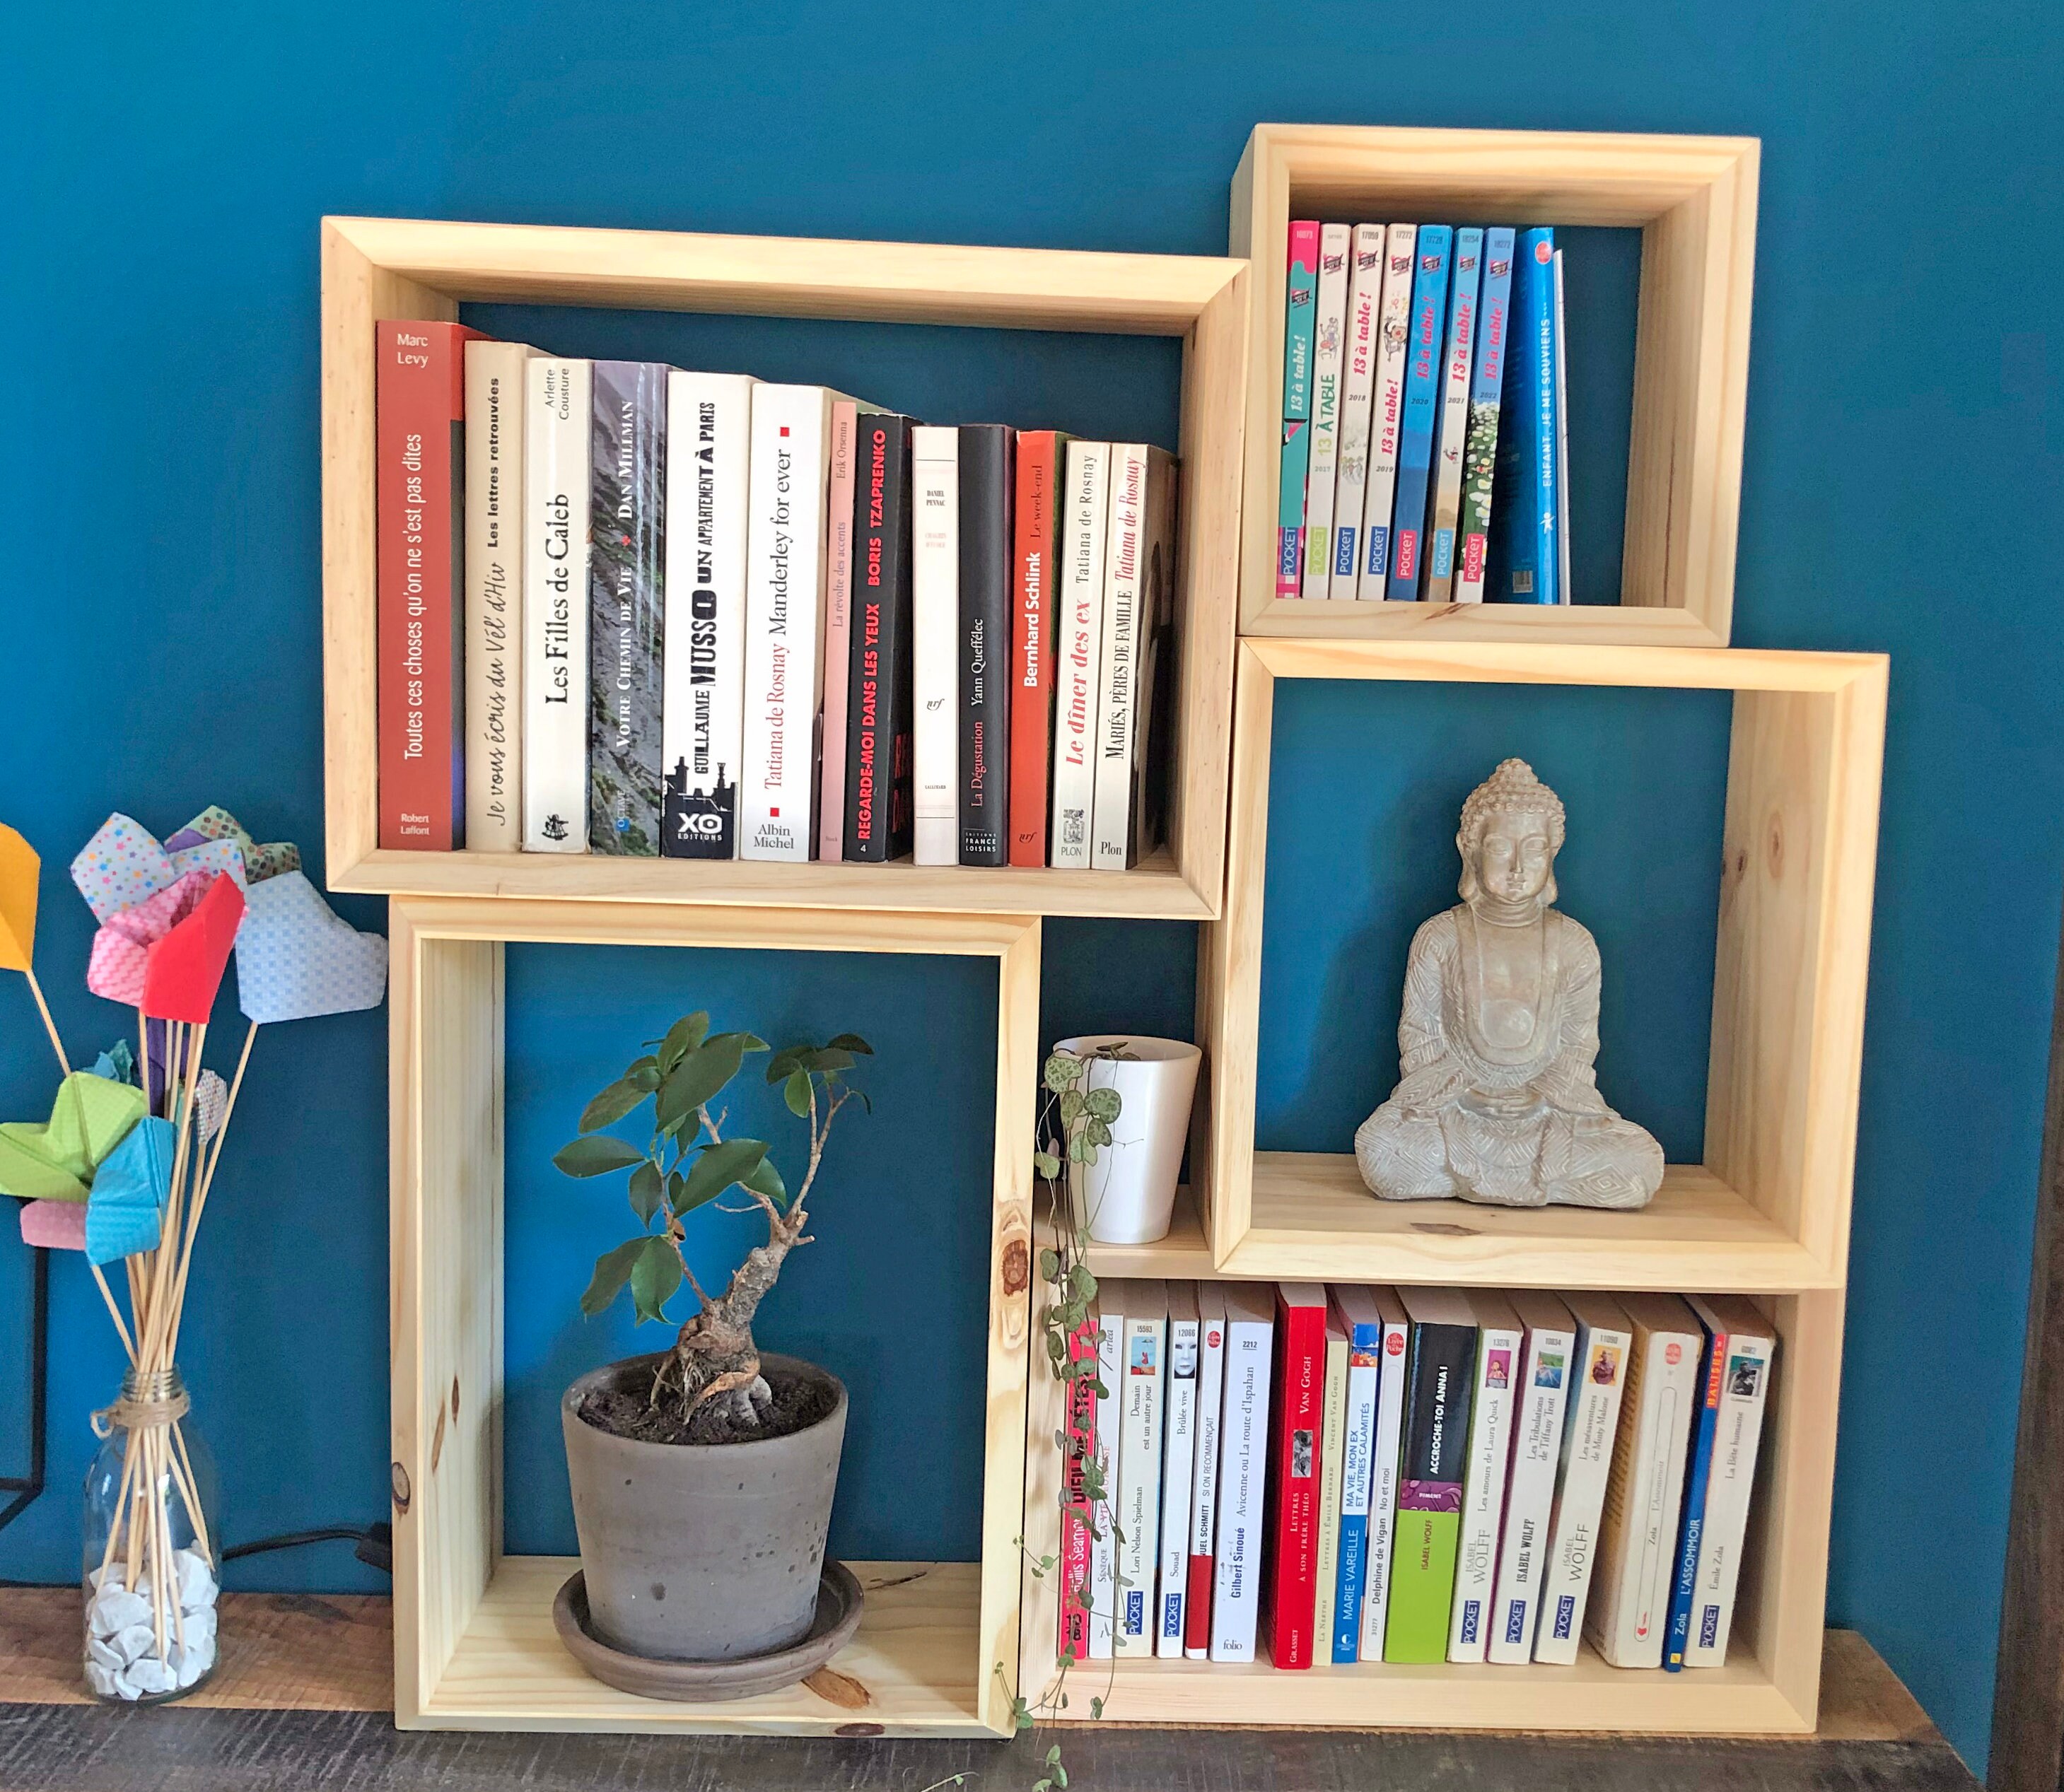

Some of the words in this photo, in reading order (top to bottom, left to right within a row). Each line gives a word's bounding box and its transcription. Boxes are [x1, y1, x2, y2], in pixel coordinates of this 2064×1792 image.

[397, 334, 428, 347] Marc
[1292, 334, 1307, 380] table!
[397, 352, 429, 368] Levy
[544, 368, 556, 409] Arlette
[558, 368, 570, 421] Cousture
[1290, 396, 1303, 412] 13
[1320, 373, 1336, 418] TABLE
[1541, 388, 1552, 407] ME
[486, 377, 499, 461] retrouvées
[1314, 420, 1336, 432] À
[1380, 426, 1396, 435] à
[1541, 411, 1552, 425] JE
[401, 433, 422, 472] dites
[618, 400, 634, 478] MILLMAN
[1317, 438, 1332, 457] 13
[1380, 439, 1394, 455] 13
[777, 449, 792, 493] ever
[869, 429, 887, 528] TZAPRENKO
[1078, 455, 1098, 504] Rosnay
[1119, 456, 1144, 506] Rosnay
[405, 476, 427, 503] pas
[487, 467, 498, 517] lettres
[617, 484, 633, 519] DAN
[1031, 464, 1044, 521] week-end
[402, 508, 423, 543] s'est
[544, 493, 569, 561] Caleb
[769, 497, 791, 526] for
[1077, 509, 1092, 527] de
[1118, 510, 1138, 527] de
[487, 522, 498, 549] Les
[1030, 522, 1042, 539] Le
[406, 547, 423, 568] ne
[868, 537, 882, 586] BORIS
[1075, 532, 1092, 584] Tatiana
[1114, 532, 1136, 582] Tatiana
[1282, 527, 1296, 575] POCKET
[1339, 528, 1353, 573] POCKET
[1370, 528, 1385, 573] POCKET
[1400, 532, 1413, 577] POCKET
[1436, 530, 1451, 575] POCKET
[1467, 534, 1481, 580] POCKET
[403, 572, 428, 617] qu'on
[545, 567, 569, 593] de
[617, 566, 632, 596] VIE
[768, 529, 793, 636] Manderley
[1025, 551, 1042, 610] Schlink
[619, 601, 632, 621] DE
[864, 604, 880, 647] YEUX
[1074, 597, 1091, 625] ex
[544, 598, 569, 660] Filles
[969, 618, 986, 674] Queffélec
[403, 621, 423, 676] choses
[616, 627, 632, 691] CHEMIN
[863, 650, 879, 677] LES
[1023, 613, 1040, 687] Bernhard
[1069, 631, 1090, 668] des
[545, 666, 569, 705] Les
[766, 643, 791, 704] Rosnay
[407, 680, 423, 707] ces
[861, 681, 878, 727] DANS
[971, 677, 984, 706] Yann
[1066, 672, 1088, 734] dîner
[616, 695, 631, 748] VOTRE
[766, 707, 784, 727] de
[404, 711, 423, 760] Toutes
[1065, 740, 1085, 766] Le
[763, 730, 784, 790] Tatiana
[969, 721, 986, 790] Dégustation
[858, 732, 875, 841] REGARDE-MOI
[971, 792, 984, 807] La
[677, 812, 723, 833] XO
[757, 824, 791, 837] Albin
[753, 836, 794, 850] Michel
[1061, 846, 1082, 857] PLON
[1100, 841, 1122, 856] Plon
[1300, 1356, 1312, 1388] GOGH
[1131, 1385, 1141, 1417] Demain
[1143, 1385, 1153, 1402] jour
[1178, 1390, 1188, 1407] vive
[1242, 1366, 1256, 1415] d'Ispahan
[1299, 1392, 1311, 1415] VAN
[1175, 1407, 1188, 1435] Brûlée
[1242, 1416, 1252, 1441] route
[1358, 1402, 1370, 1456] CALAMITÉS
[1486, 1399, 1500, 1424] Quick
[1529, 1396, 1545, 1443] Tribulations
[1143, 1427, 1150, 1437] un
[1203, 1417, 1215, 1475] RECOMMENÇAIT
[1239, 1443, 1250, 1456] La
[1483, 1427, 1496, 1451] Laura
[1240, 1458, 1249, 1471] ou
[1481, 1453, 1493, 1464] de
[1526, 1445, 1537, 1460] Les
[1202, 1476, 1211, 1488] ON
[1356, 1458, 1368, 1494] AUTRES
[1381, 1468, 1391, 1485] moi
[1381, 1487, 1389, 1496] et
[1481, 1465, 1492, 1495] amours
[1132, 1487, 1144, 1525] Spielman
[1236, 1474, 1249, 1517] Avicenne
[1289, 1492, 1300, 1533] LETTRES
[1355, 1497, 1364, 1508] ET
[1379, 1498, 1389, 1511] No
[1476, 1496, 1488, 1512] Les
[1131, 1526, 1142, 1554] Nelson
[1232, 1527, 1245, 1562] Sinoué
[1375, 1518, 1388, 1546] Vigan
[1423, 1519, 1433, 1545] WOLFF
[1130, 1556, 1141, 1574] Lori
[1169, 1551, 1180, 1578] Souad
[1344, 1529, 1359, 1581] VAREILLE
[1375, 1548, 1385, 1561] de
[1421, 1547, 1431, 1571] ISABEL
[1473, 1528, 1491, 1584] WOLFF
[1568, 1523, 1590, 1581] WOLFF
[1679, 1518, 1701, 1595] L'ASSOMMOIR
[1712, 1545, 1725, 1566] Zola
[1230, 1564, 1244, 1599] Gilbert
[1372, 1563, 1385, 1605] Delphine
[1708, 1567, 1722, 1591] Émile
[1129, 1591, 1141, 1635] POCKET
[1165, 1593, 1179, 1637] POCKET
[1342, 1584, 1356, 1620] MARIE
[1555, 1595, 1573, 1639] POCKET
[1463, 1600, 1479, 1644] POCKET
[1508, 1599, 1525, 1643] POCKET
[1675, 1612, 1688, 1636] Zola
[1702, 1605, 1718, 1648] POCKET
[1223, 1639, 1243, 1651] folio
[1288, 1629, 1300, 1663] GRASSET
